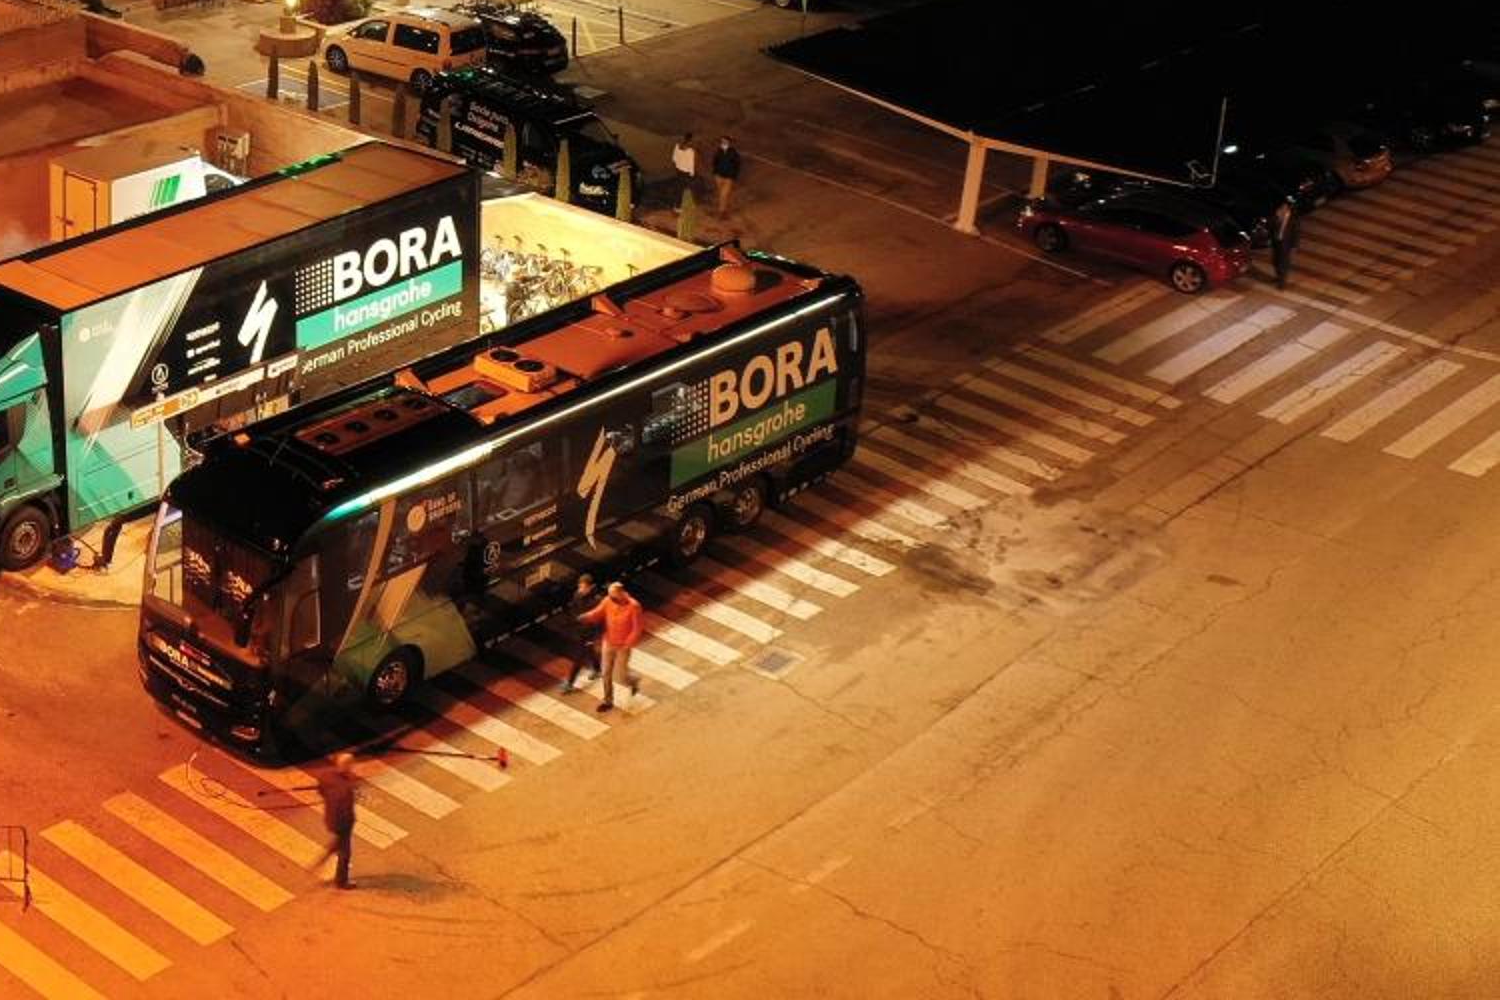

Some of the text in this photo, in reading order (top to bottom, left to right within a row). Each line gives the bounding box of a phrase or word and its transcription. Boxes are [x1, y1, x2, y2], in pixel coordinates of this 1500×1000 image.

[333, 215, 463, 302] BORA
[334, 278, 433, 332] hansgrohe
[347, 316, 419, 354] Professional
[421, 300, 463, 328] Cycling
[709, 327, 839, 428] BORA
[667, 423, 836, 514] German Professional Cycling
[707, 400, 806, 463] hansgrohe
